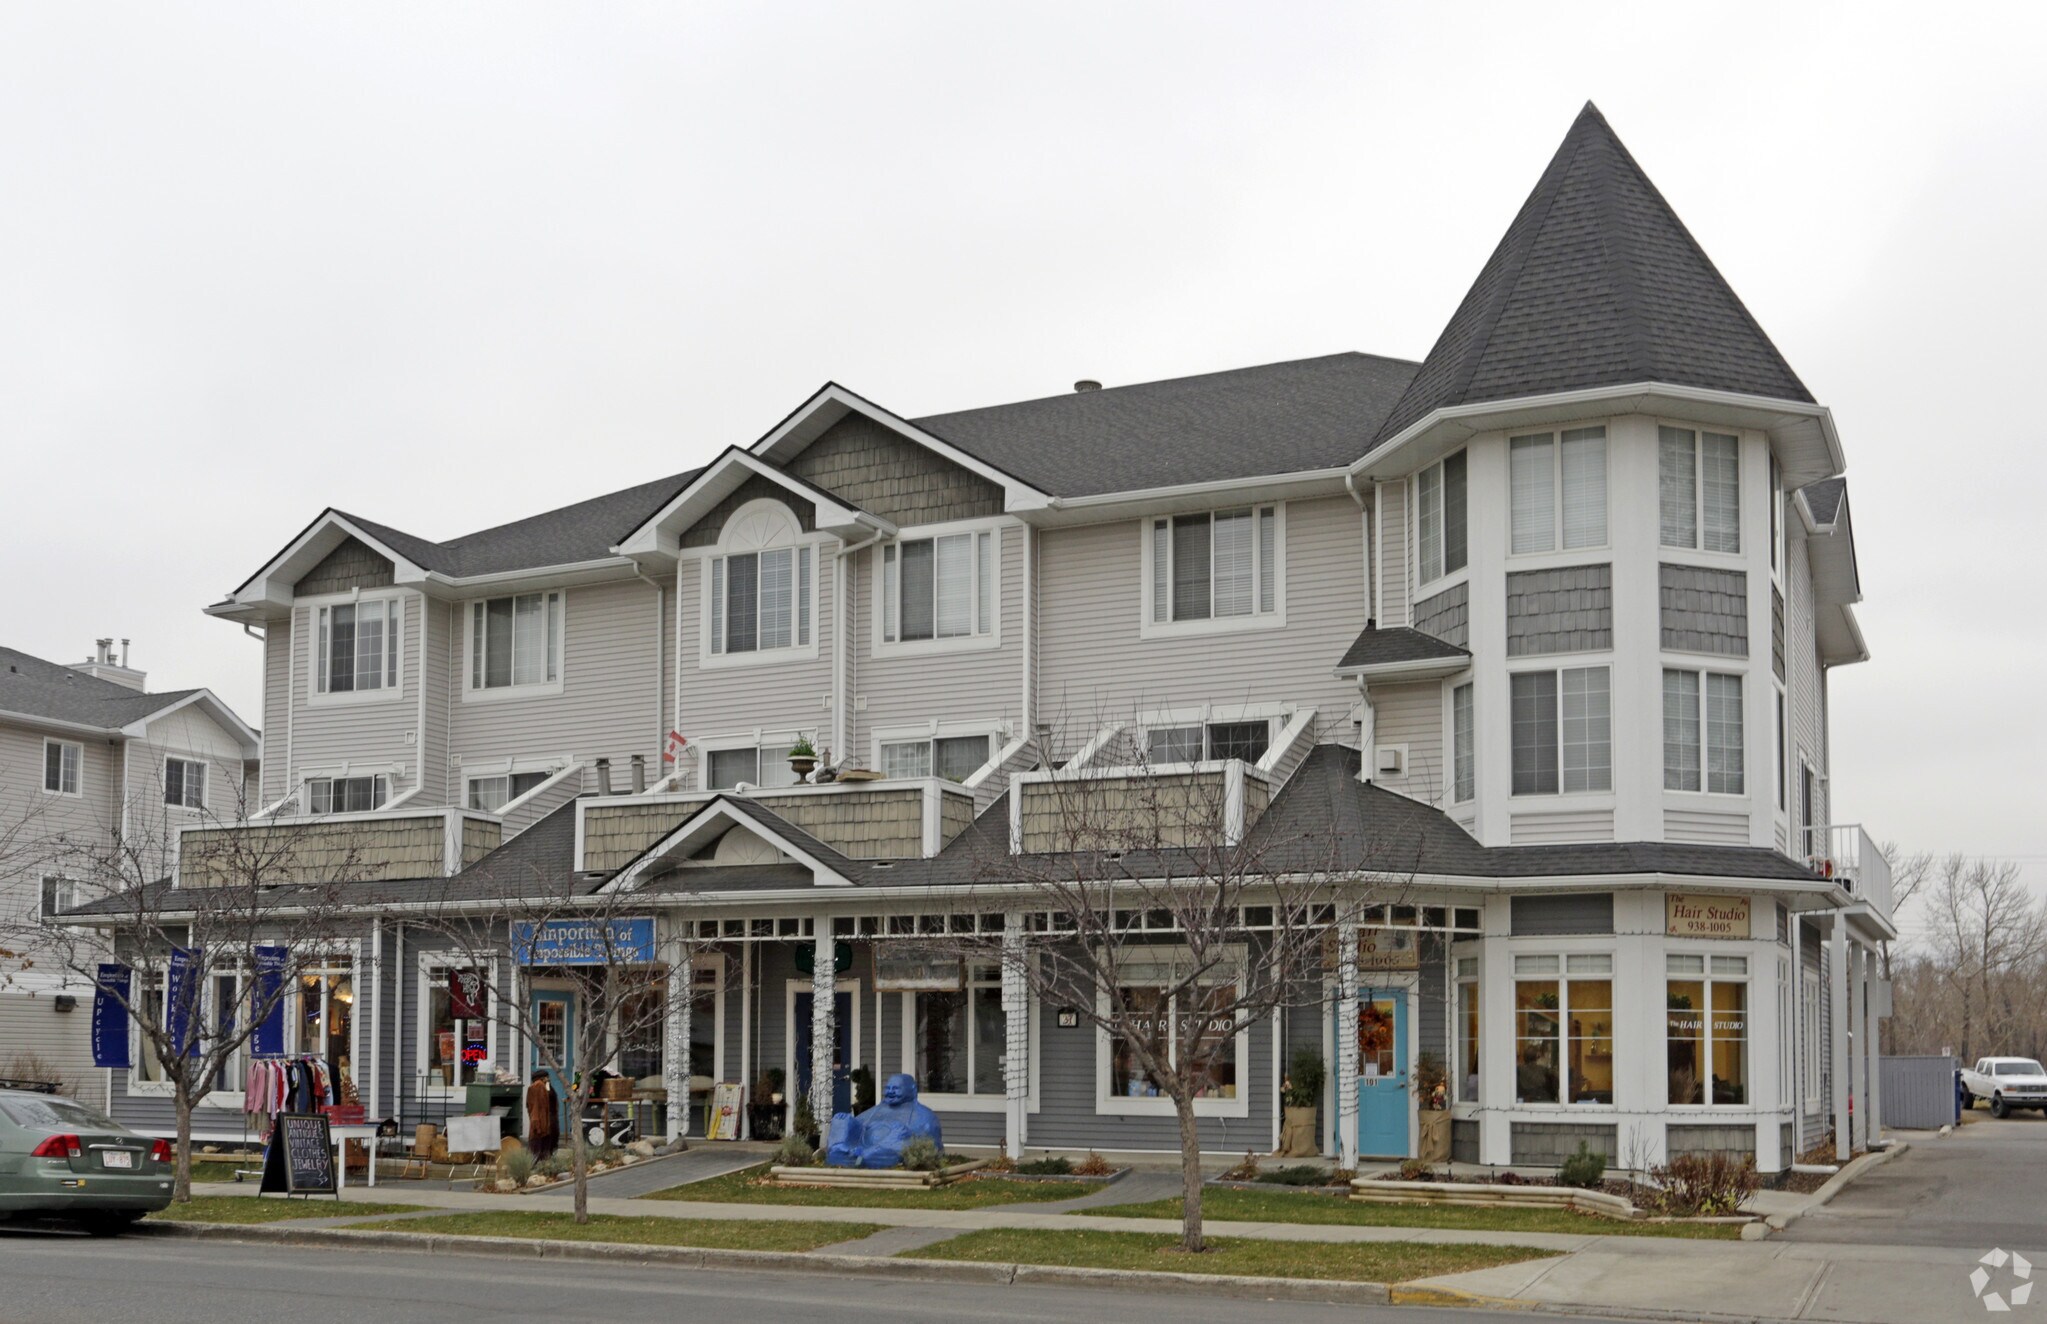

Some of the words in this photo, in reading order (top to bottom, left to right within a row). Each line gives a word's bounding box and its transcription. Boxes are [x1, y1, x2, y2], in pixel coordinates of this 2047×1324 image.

[1670, 894, 1684, 903] The
[1673, 904, 1703, 919] Hair
[1707, 905, 1746, 921] Studio
[1687, 921, 1732, 933] 938-1005
[619, 928, 633, 941] of
[593, 941, 640, 961] Tings
[1326, 939, 1377, 954] Sio
[1130, 1019, 1168, 1032] HAR
[1181, 1019, 1233, 1032] STDIO
[1680, 1020, 1703, 1030] HAIR
[1714, 1021, 1744, 1030] STUDIO
[461, 1049, 487, 1061] OPEN
[1366, 1078, 1378, 1086] 101
[287, 1119, 323, 1131] UNIQUE
[288, 1129, 324, 1139] ANTIQUES
[289, 1138, 320, 1148] VINTAGE
[291, 1148, 327, 1159] CLOTHES
[293, 1159, 329, 1170] JEWELRY
